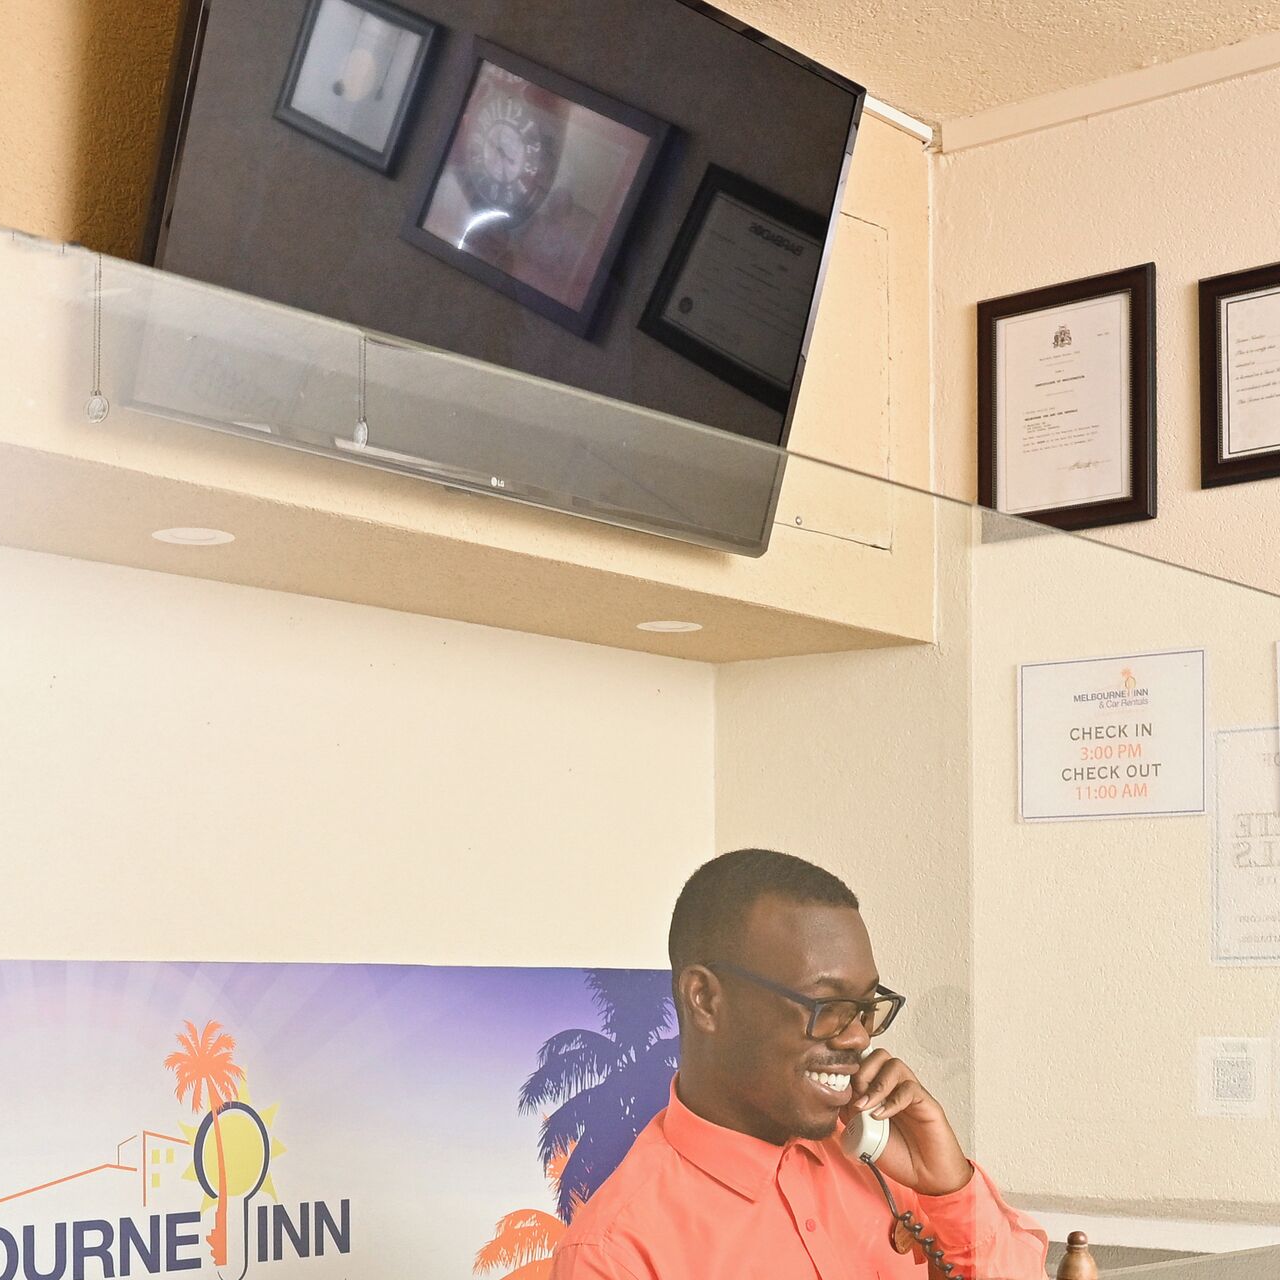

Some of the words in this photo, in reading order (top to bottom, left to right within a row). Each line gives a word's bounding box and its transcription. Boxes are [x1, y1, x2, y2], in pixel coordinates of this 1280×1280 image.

[1073, 690, 1126, 703] MELBOURNE
[1133, 689, 1149, 697] INN
[1070, 724, 1128, 741] CHECK
[1135, 723, 1152, 738] IN
[1080, 745, 1113, 760] 3:00
[1118, 743, 1142, 759] PM
[1061, 765, 1120, 781] CHECK
[1126, 763, 1162, 778] OUT
[1075, 785, 1117, 800] 11:00
[1122, 783, 1148, 798] AM
[257, 1198, 351, 1264] INN
